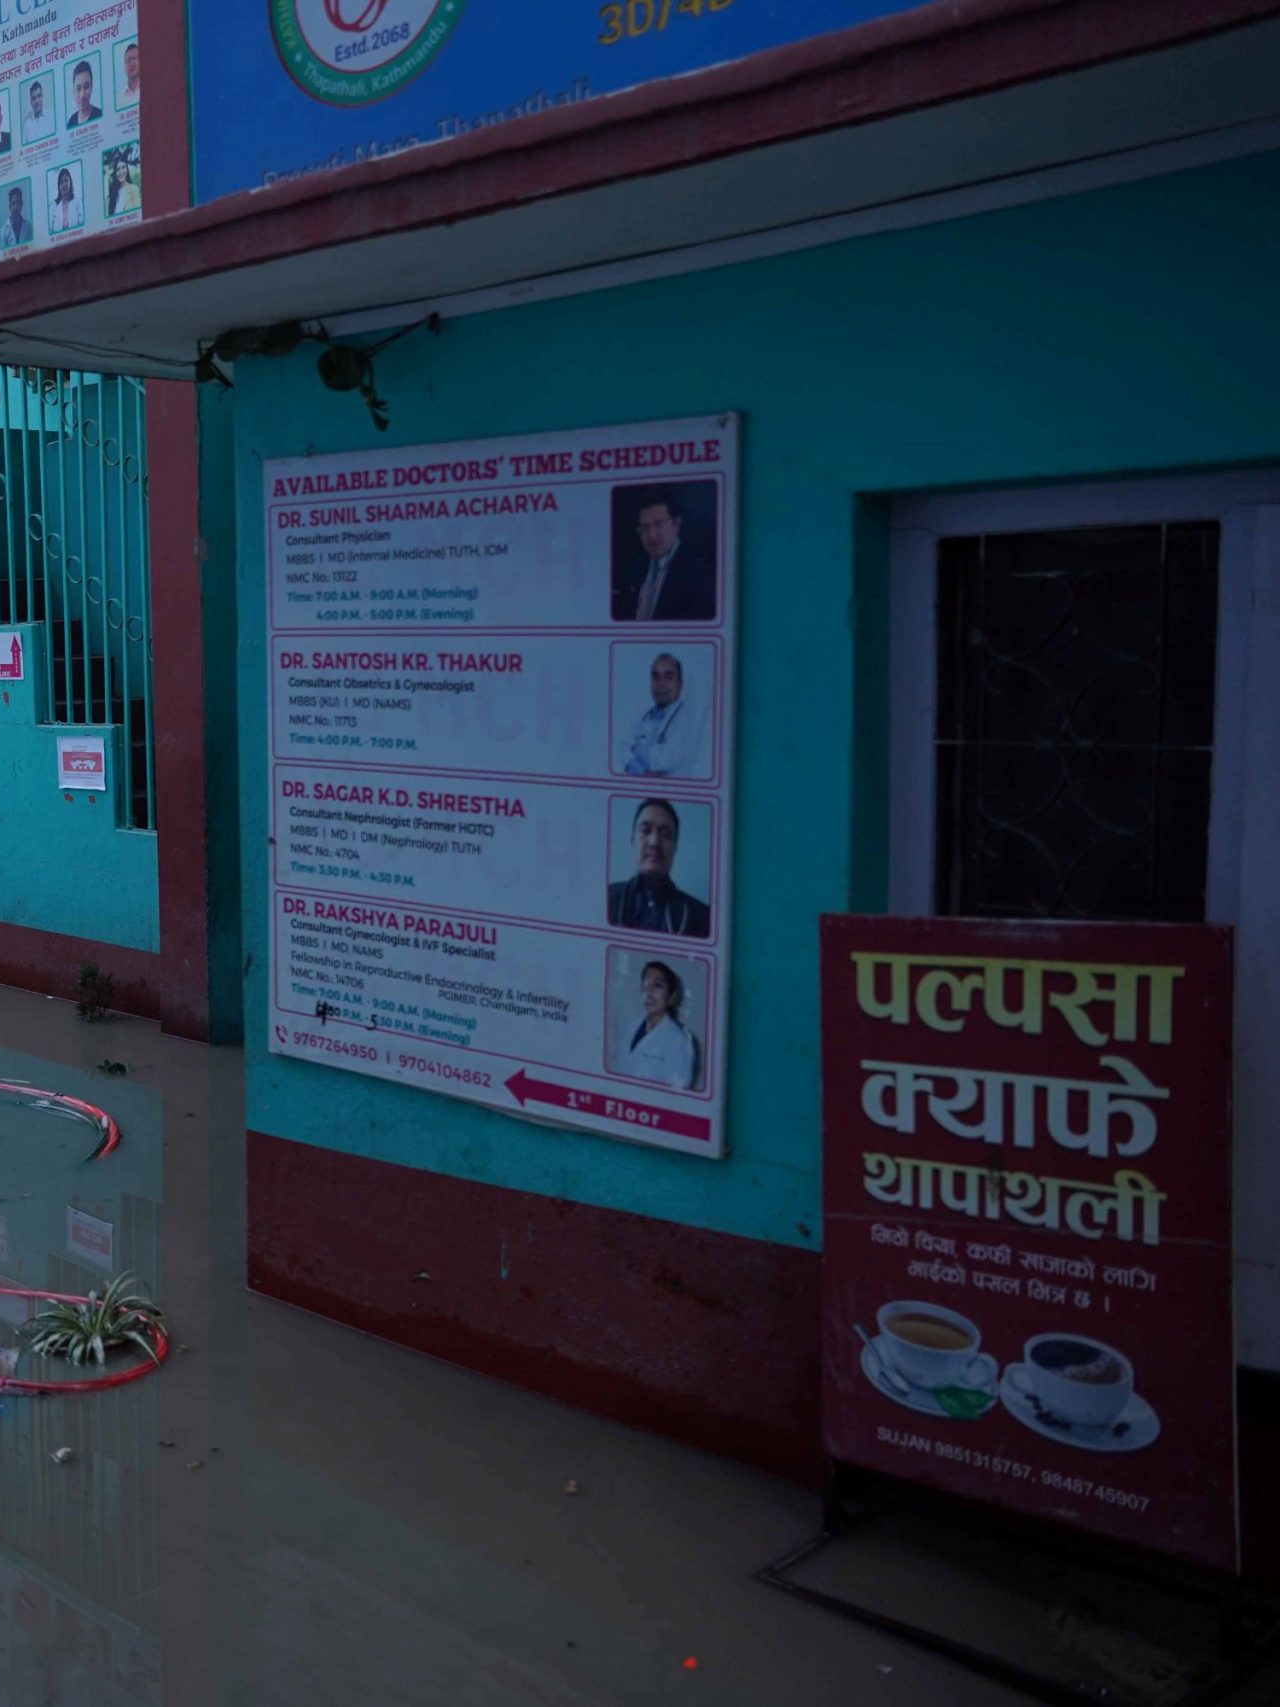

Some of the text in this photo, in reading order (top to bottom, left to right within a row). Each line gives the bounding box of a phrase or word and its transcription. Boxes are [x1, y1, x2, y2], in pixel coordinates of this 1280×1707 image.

[2, 10, 57, 44] Kathmandu
[335, 22, 410, 62] Estd.2068
[371, 21, 447, 92] Kathmandu
[273, 439, 719, 497] AVAILABLE DOCTORS' TIME SCHEDULE
[278, 492, 558, 528] DR. SUNIL SHARMA ACHARYA
[286, 531, 390, 546] Consultant Physician
[286, 553, 315, 565] MBBS
[328, 551, 345, 563] MD
[348, 549, 390, 562] (Internal
[392, 547, 445, 561] Medicine)
[280, 653, 523, 673] DR. SANTOSH KR. THAKUR
[288, 677, 341, 689] Consultant
[394, 679, 400, 690] &
[403, 679, 474, 694] Gynecologist
[289, 696, 317, 707] MBBS
[353, 698, 370, 708] MD
[373, 698, 411, 711] (NAMS)
[282, 781, 525, 818] DR. SAGAR K.D. SHRESTHA
[290, 806, 342, 821] Consultant
[344, 812, 411, 829] Nephrologist
[413, 818, 456, 832] (Former
[290, 825, 481, 854] MBBS MD DM (Nephrology) TUTH
[283, 897, 497, 945] DR. RAKSHYA PARAJULI
[291, 919, 496, 961] Consultant Gynecologist & IVF Specialist
[291, 935, 319, 948] MBBS
[352, 945, 383, 959] NAMS
[291, 951, 569, 1011] Fellowship in Reproductive Endocrinology & Infertility
[542, 1011, 567, 1022] India
[850, 951, 1185, 1047] पल्पसा
[293, 1032, 492, 1088] 9767264950 9704104862
[605, 1100, 661, 1126] Floor
[860, 1056, 1169, 1159] क्याफे
[862, 1151, 1167, 1246] थापाथली
[877, 1426, 930, 1453] SUJAN
